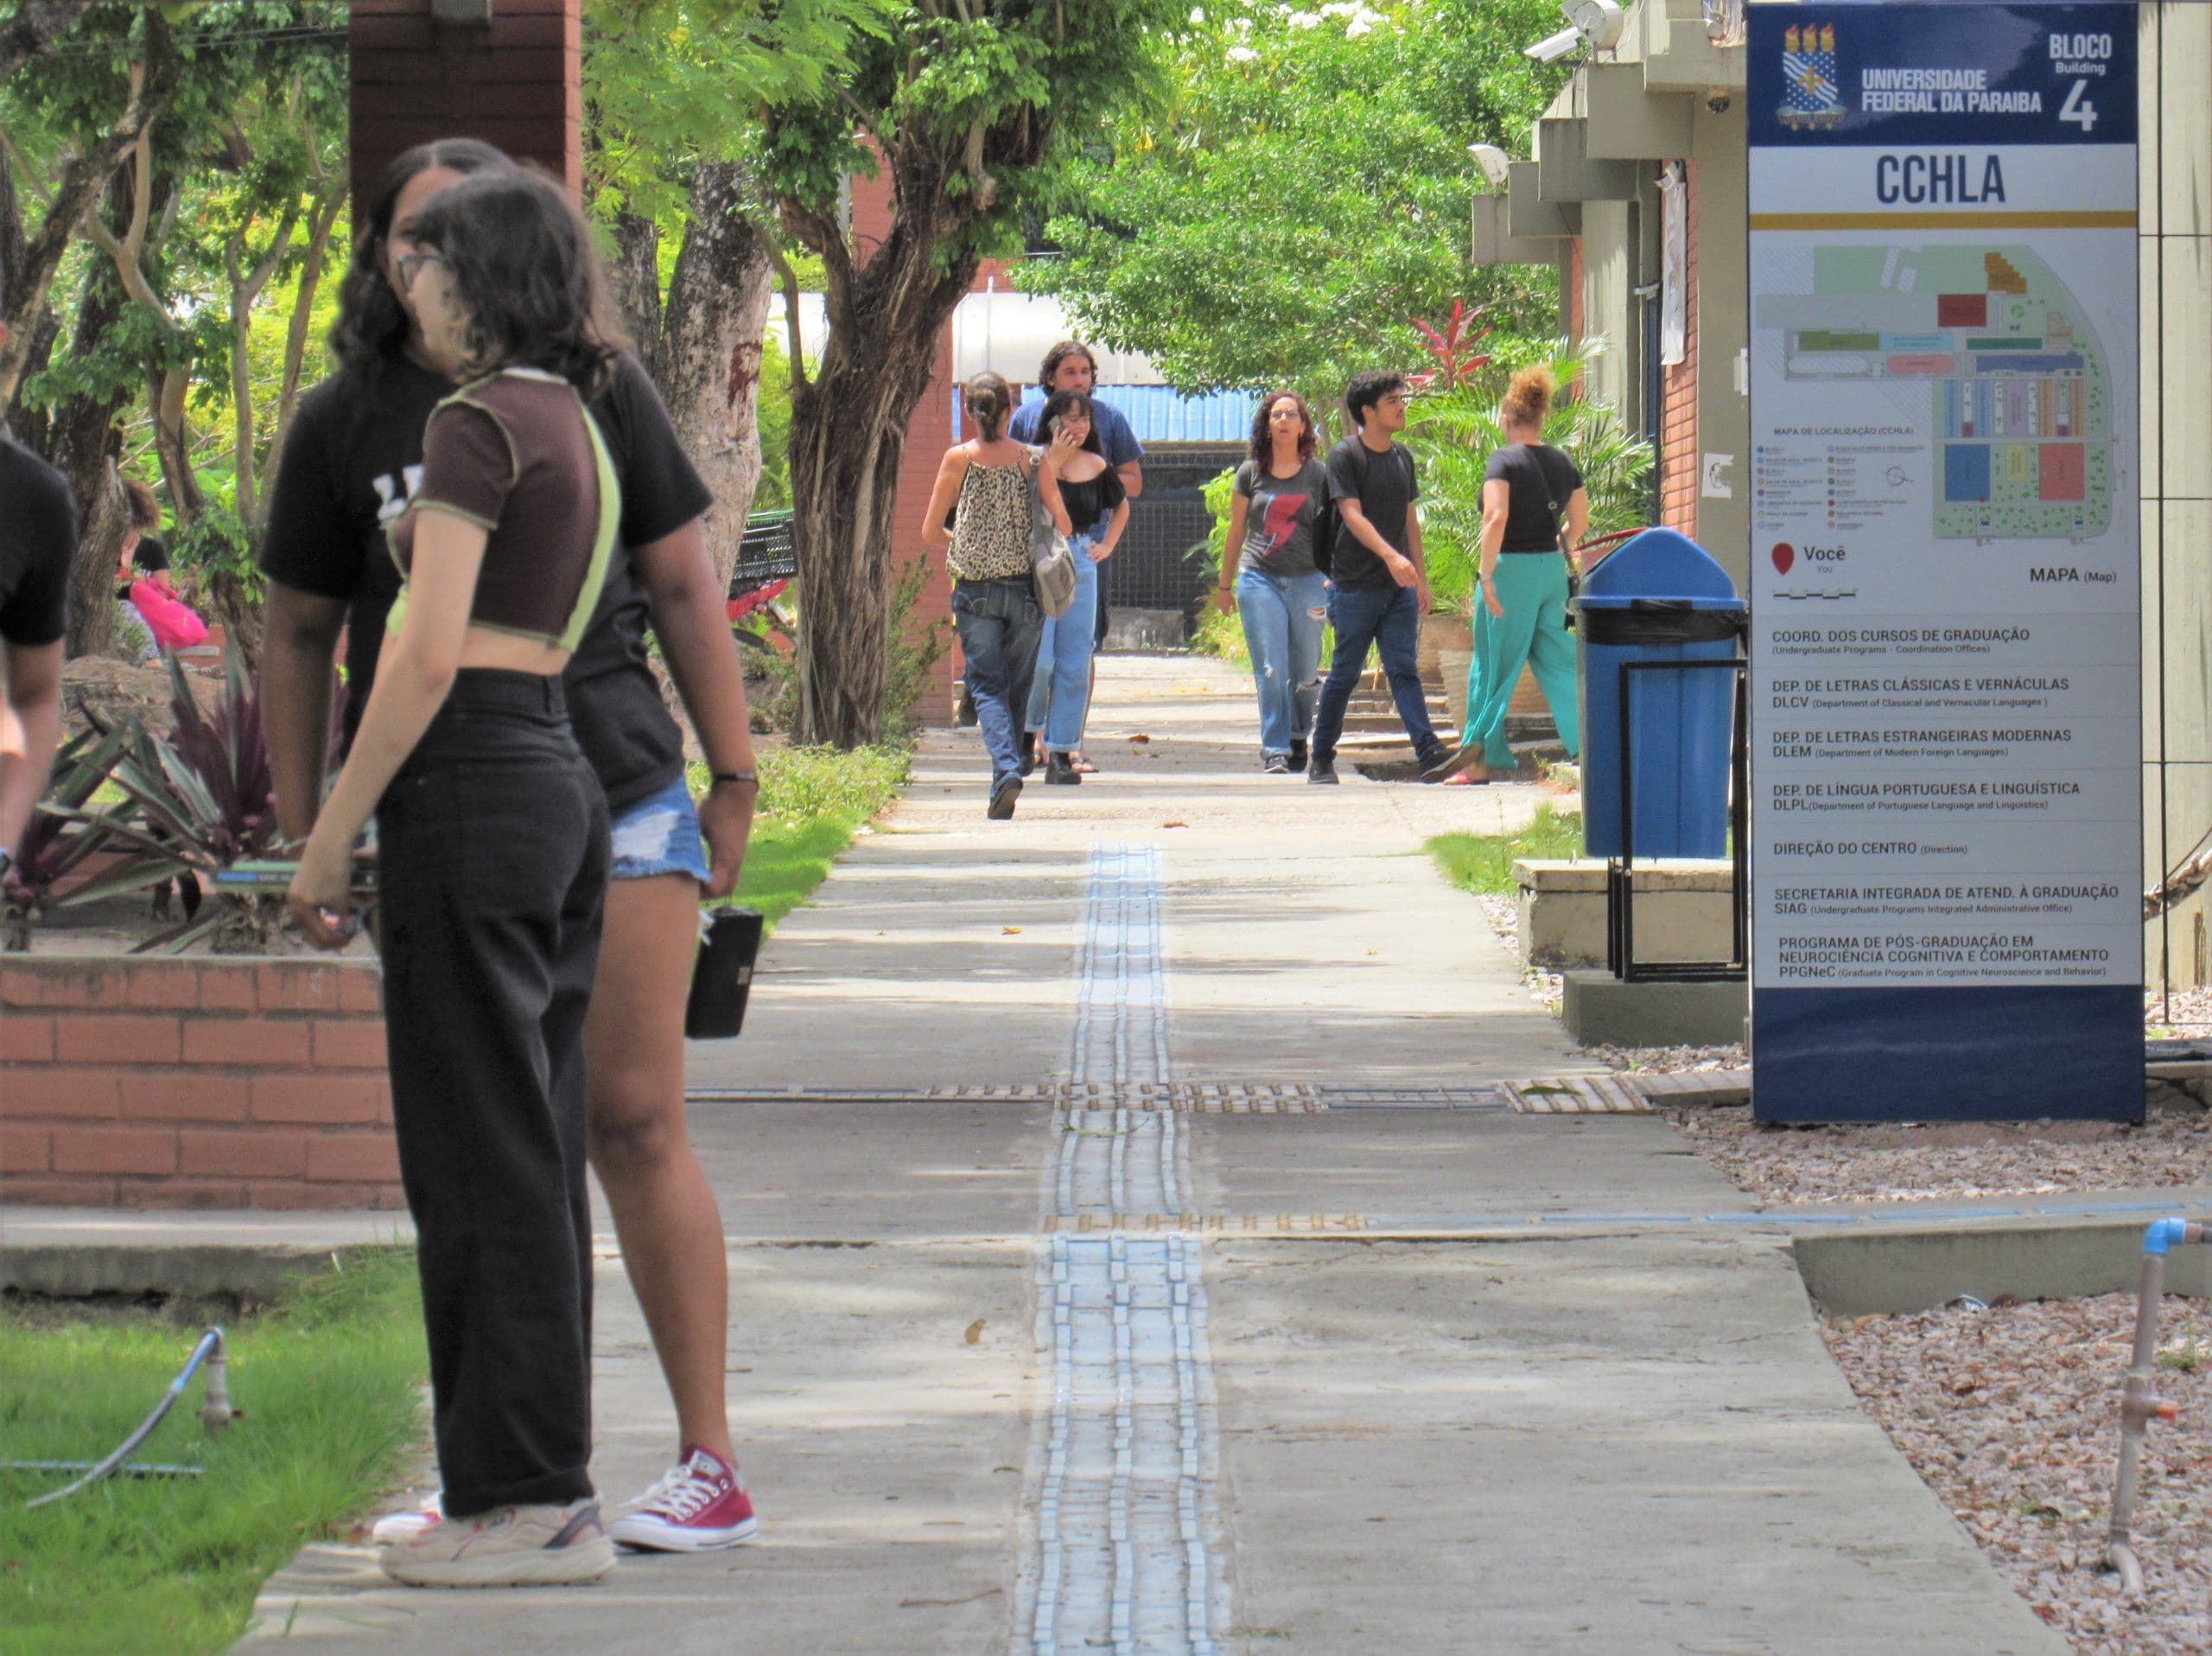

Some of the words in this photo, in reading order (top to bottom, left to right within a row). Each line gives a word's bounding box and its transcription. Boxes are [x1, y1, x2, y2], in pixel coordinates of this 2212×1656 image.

[2049, 33, 2113, 61] BLOCO
[2055, 62, 2107, 76] Building
[1862, 68, 1987, 91] UNIVERSIDADE
[1862, 92, 1937, 113] FEDERAL
[1940, 92, 1963, 113] DA
[1967, 91, 2043, 113] PARAIBA
[2058, 78, 2098, 132] 4
[1876, 154, 2007, 204] CCHLA
[1773, 427, 1799, 436] MAPA
[1815, 426, 1877, 436] LOCALIZAÇÃO
[1878, 427, 1915, 436] (CCHLA)
[1803, 545, 1847, 562] Você
[1816, 564, 1833, 574] You
[2029, 568, 2080, 583] MAPA
[2082, 570, 2117, 583] (Map)
[1771, 630, 1824, 642] COORD.
[1828, 630, 1857, 642] DOS
[1860, 629, 1918, 642] CURSOS
[1922, 629, 1940, 641] DE
[1943, 627, 2030, 644] GRADUAÇÃO
[1771, 646, 1841, 655] (Undergraduate
[1844, 646, 1886, 655] Programs
[1896, 645, 1953, 653] Coordination
[1955, 644, 1991, 654] Offices)
[1772, 680, 1801, 692] DEP.
[1805, 680, 1823, 691] DE
[1827, 679, 1879, 691] LETRAS
[1883, 677, 1960, 691] CLÁSSICAS
[1964, 678, 1973, 690] E
[1975, 675, 2069, 690] VERNÁCULAS
[1772, 697, 1808, 708] DLCV
[1812, 699, 1868, 709] (Department
[1870, 698, 1880, 707] of
[1881, 698, 1923, 707] Classical
[1943, 698, 1991, 707] Vernacular
[1773, 731, 1801, 743] DEP.
[1805, 731, 1823, 743] DE
[1827, 731, 1879, 742] LETRAS
[1883, 730, 1988, 742] ESTRANGEIRAS
[1992, 729, 2072, 742] MODERNAS
[1773, 746, 1811, 758] DLEM
[1815, 748, 1871, 759] (Department
[1885, 748, 1918, 757] Modern
[1921, 748, 1955, 757] Foreign
[1956, 748, 2009, 757] Languages)
[1773, 784, 1802, 796] DEP.
[1806, 784, 1823, 796] DE
[1827, 781, 1879, 796] LÍNGUA
[1883, 783, 1977, 795] PORTUGUESA
[1980, 783, 1989, 794] E
[1992, 780, 2080, 795] LINGUÍSTICA
[1866, 801, 1876, 810] of
[1878, 800, 1929, 812] Portuguese
[1931, 800, 1974, 811] Language
[1977, 800, 1993, 809] and
[1996, 800, 2048, 810] Linguistics)
[1774, 840, 1834, 857] DIREÇÃO
[1838, 843, 1858, 854] DO
[1861, 842, 1917, 854] CENTRO
[1921, 844, 1967, 855] (Direction)
[1775, 888, 1858, 901] SECRETARIA
[1863, 887, 1941, 899] INTEGRADA
[1945, 887, 1963, 899] DE
[1967, 887, 2015, 899] ATEND.
[2019, 883, 2028, 899] À
[2032, 882, 2119, 901] GRADUAÇÃO
[1775, 902, 1807, 914] SIAG
[1811, 906, 1878, 915] (Undergraduate
[1882, 906, 1924, 915] Programs
[1928, 905, 1973, 914] Integrated
[1975, 904, 2039, 913] Administrative
[2043, 904, 2072, 914] Office)
[1779, 937, 1859, 949] PROGRAMA
[1863, 936, 1881, 948] DE
[1885, 933, 2008, 950] PÓS-GRADUAÇÃO
[2012, 935, 2033, 946] EM
[1779, 949, 1884, 963] NEUROCIÊNCIA
[1888, 950, 1963, 962] COGNITIVA
[1967, 950, 1976, 962] E
[1980, 949, 2109, 961] COMPORTAMENTO
[1779, 965, 1835, 978] PPGNeC
[1838, 969, 1883, 978] (Graduate
[1885, 969, 1923, 978] Program
[1936, 968, 1979, 978] Cognitive
[2063, 967, 2106, 977] Behavior)
